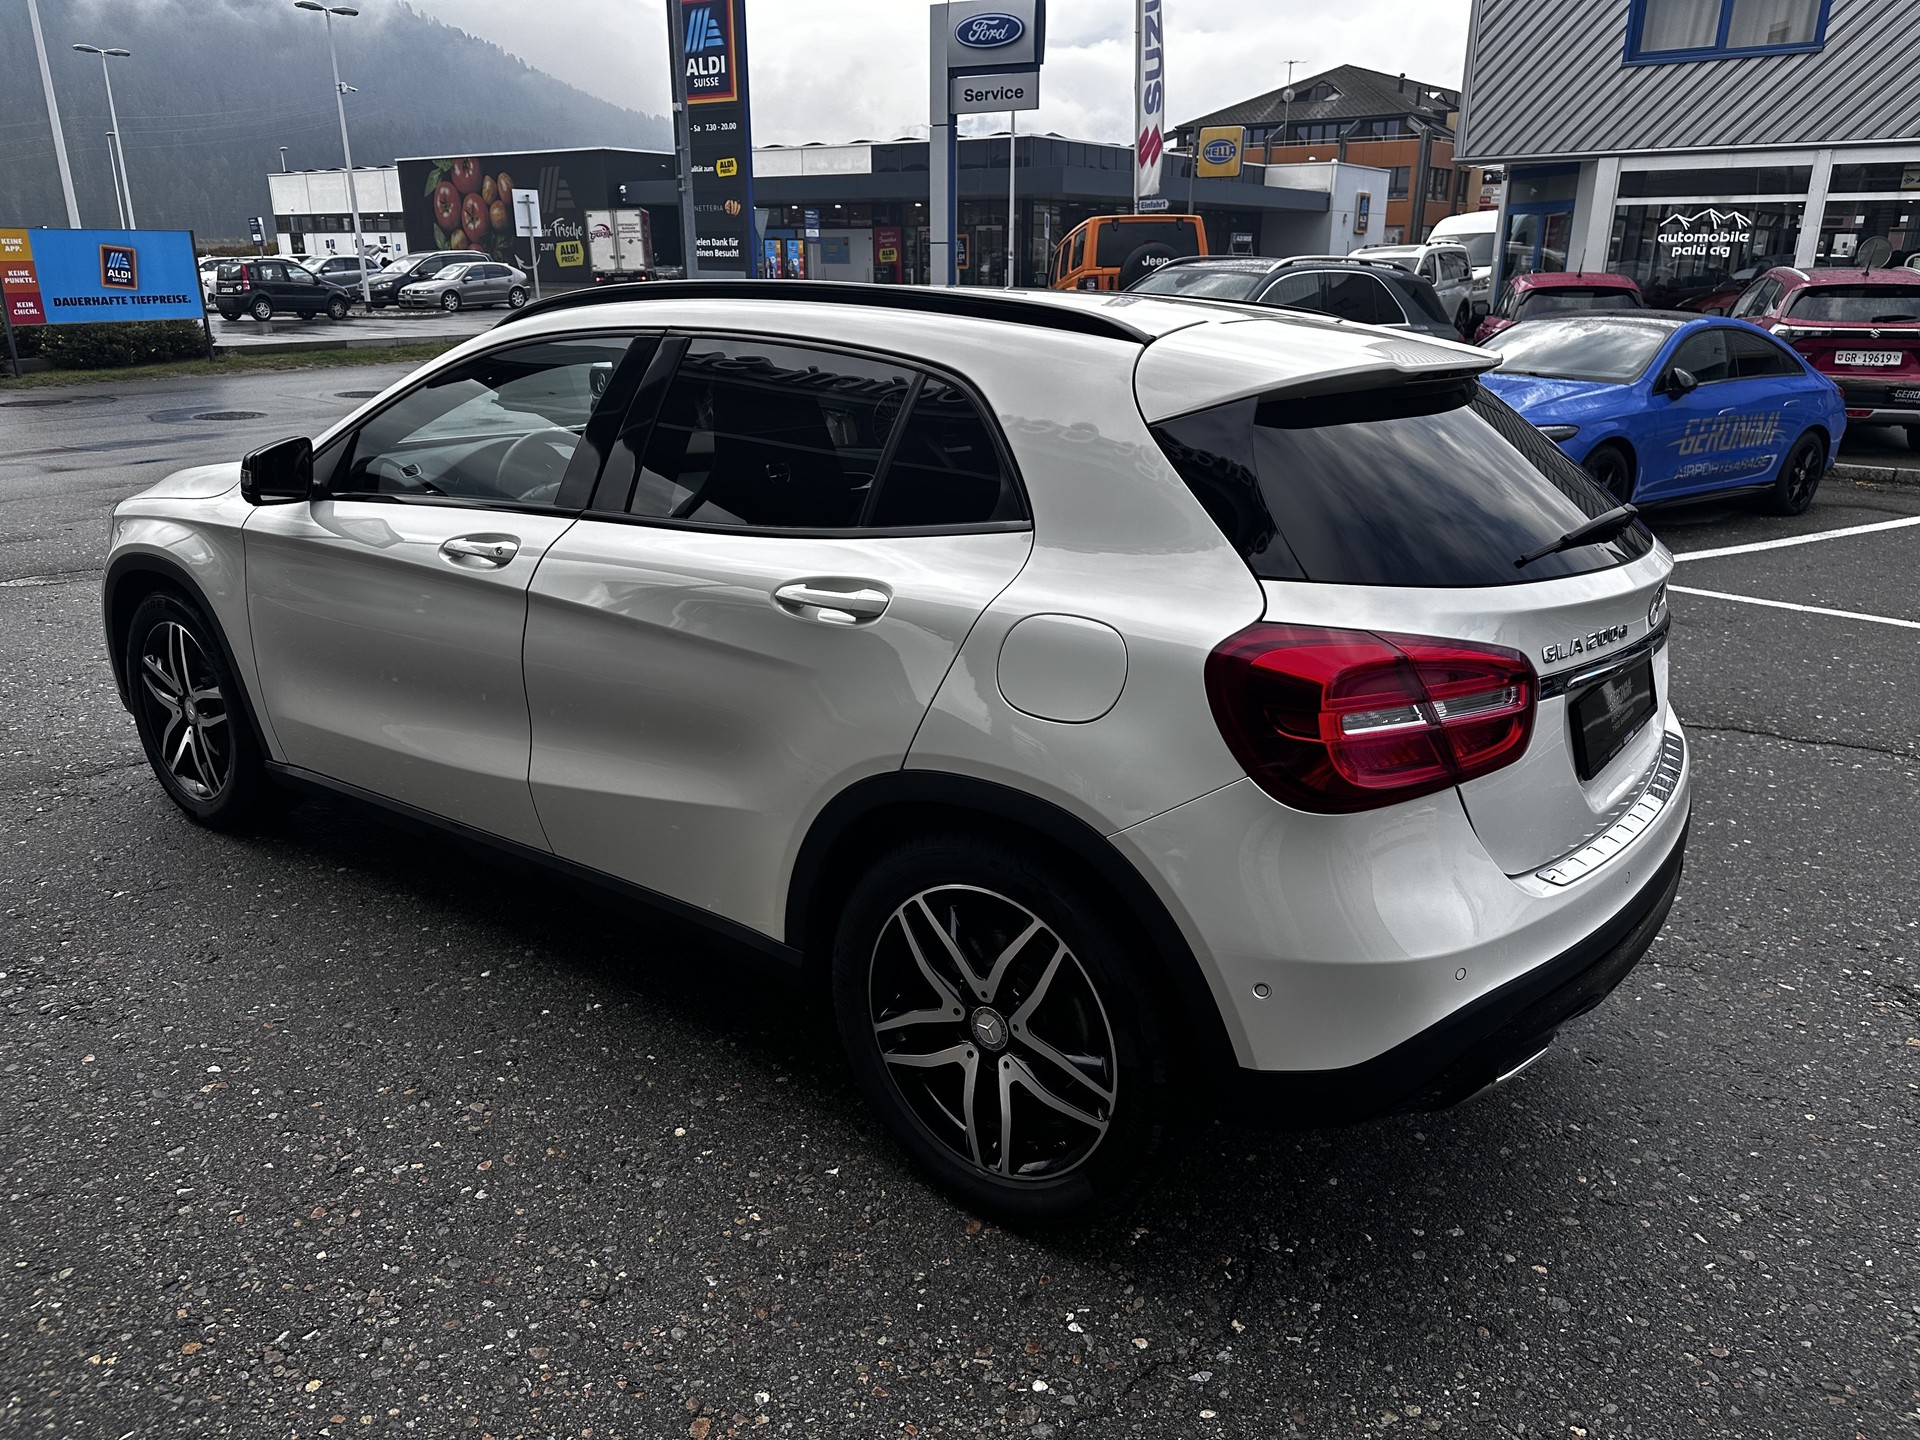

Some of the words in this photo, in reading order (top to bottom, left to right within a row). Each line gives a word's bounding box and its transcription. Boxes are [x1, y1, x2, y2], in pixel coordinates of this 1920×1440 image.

[968, 19, 1010, 42] Ford
[686, 55, 726, 76] ALDI
[693, 77, 720, 88] SUISSE
[964, 86, 1024, 102] Service
[1205, 145, 1236, 158] HELLA
[720, 160, 734, 168] ALDI
[695, 204, 723, 212] NETTERIA
[1141, 199, 1167, 209] Einfahrt
[541, 226, 553, 237] ehr
[551, 217, 584, 240] Frische
[695, 237, 710, 246] ielen
[711, 237, 728, 246] Dank
[728, 237, 739, 246] für
[1657, 231, 1750, 243] automobile
[540, 243, 554, 251] zum
[560, 243, 579, 256] ALDI
[696, 248, 714, 257] einen
[714, 249, 739, 258] Besuch!
[1671, 244, 1706, 257] palü
[1709, 246, 1731, 257] ag
[107, 269, 132, 278] ALDI
[53, 296, 128, 307] DAUERHAFTE
[129, 294, 192, 305] TIEFPREISE.
[1541, 638, 1583, 664] GLA
